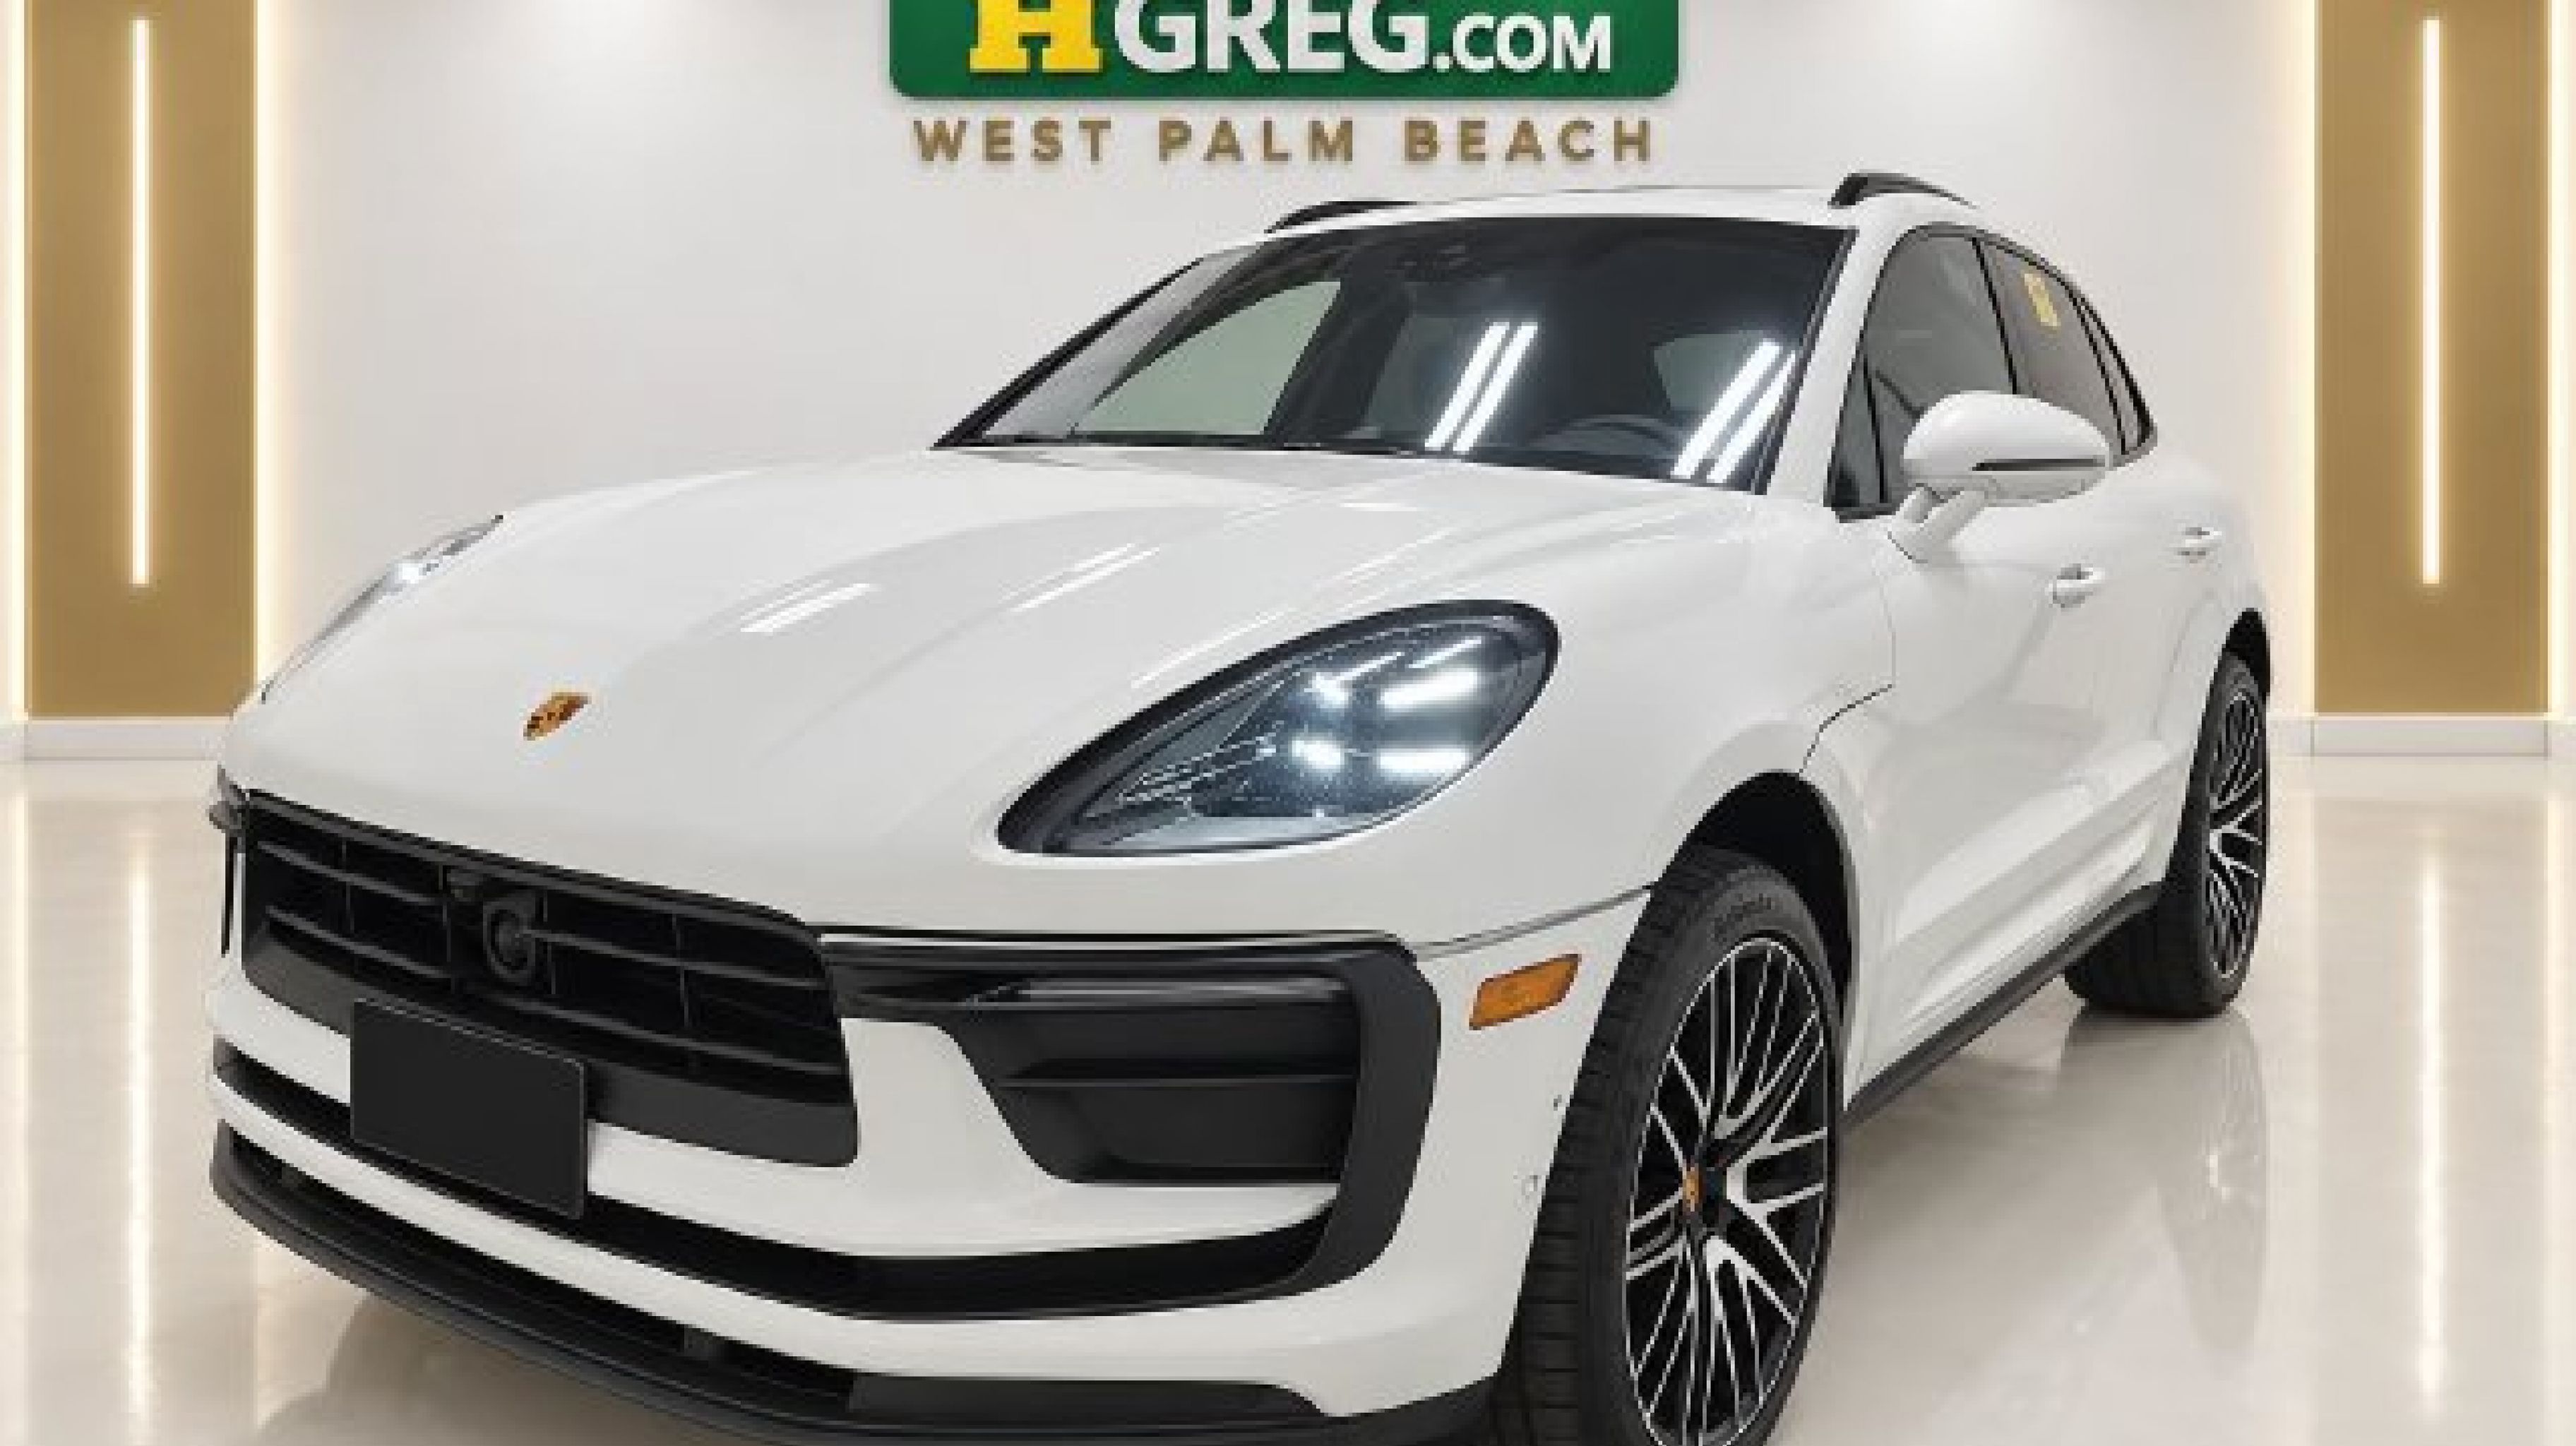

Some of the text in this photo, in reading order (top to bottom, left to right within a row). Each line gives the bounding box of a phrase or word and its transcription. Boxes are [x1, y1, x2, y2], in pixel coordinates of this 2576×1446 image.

[970, 0, 1611, 73] HGREG.COM
[912, 119, 1650, 162] WEST PALM BEACH
